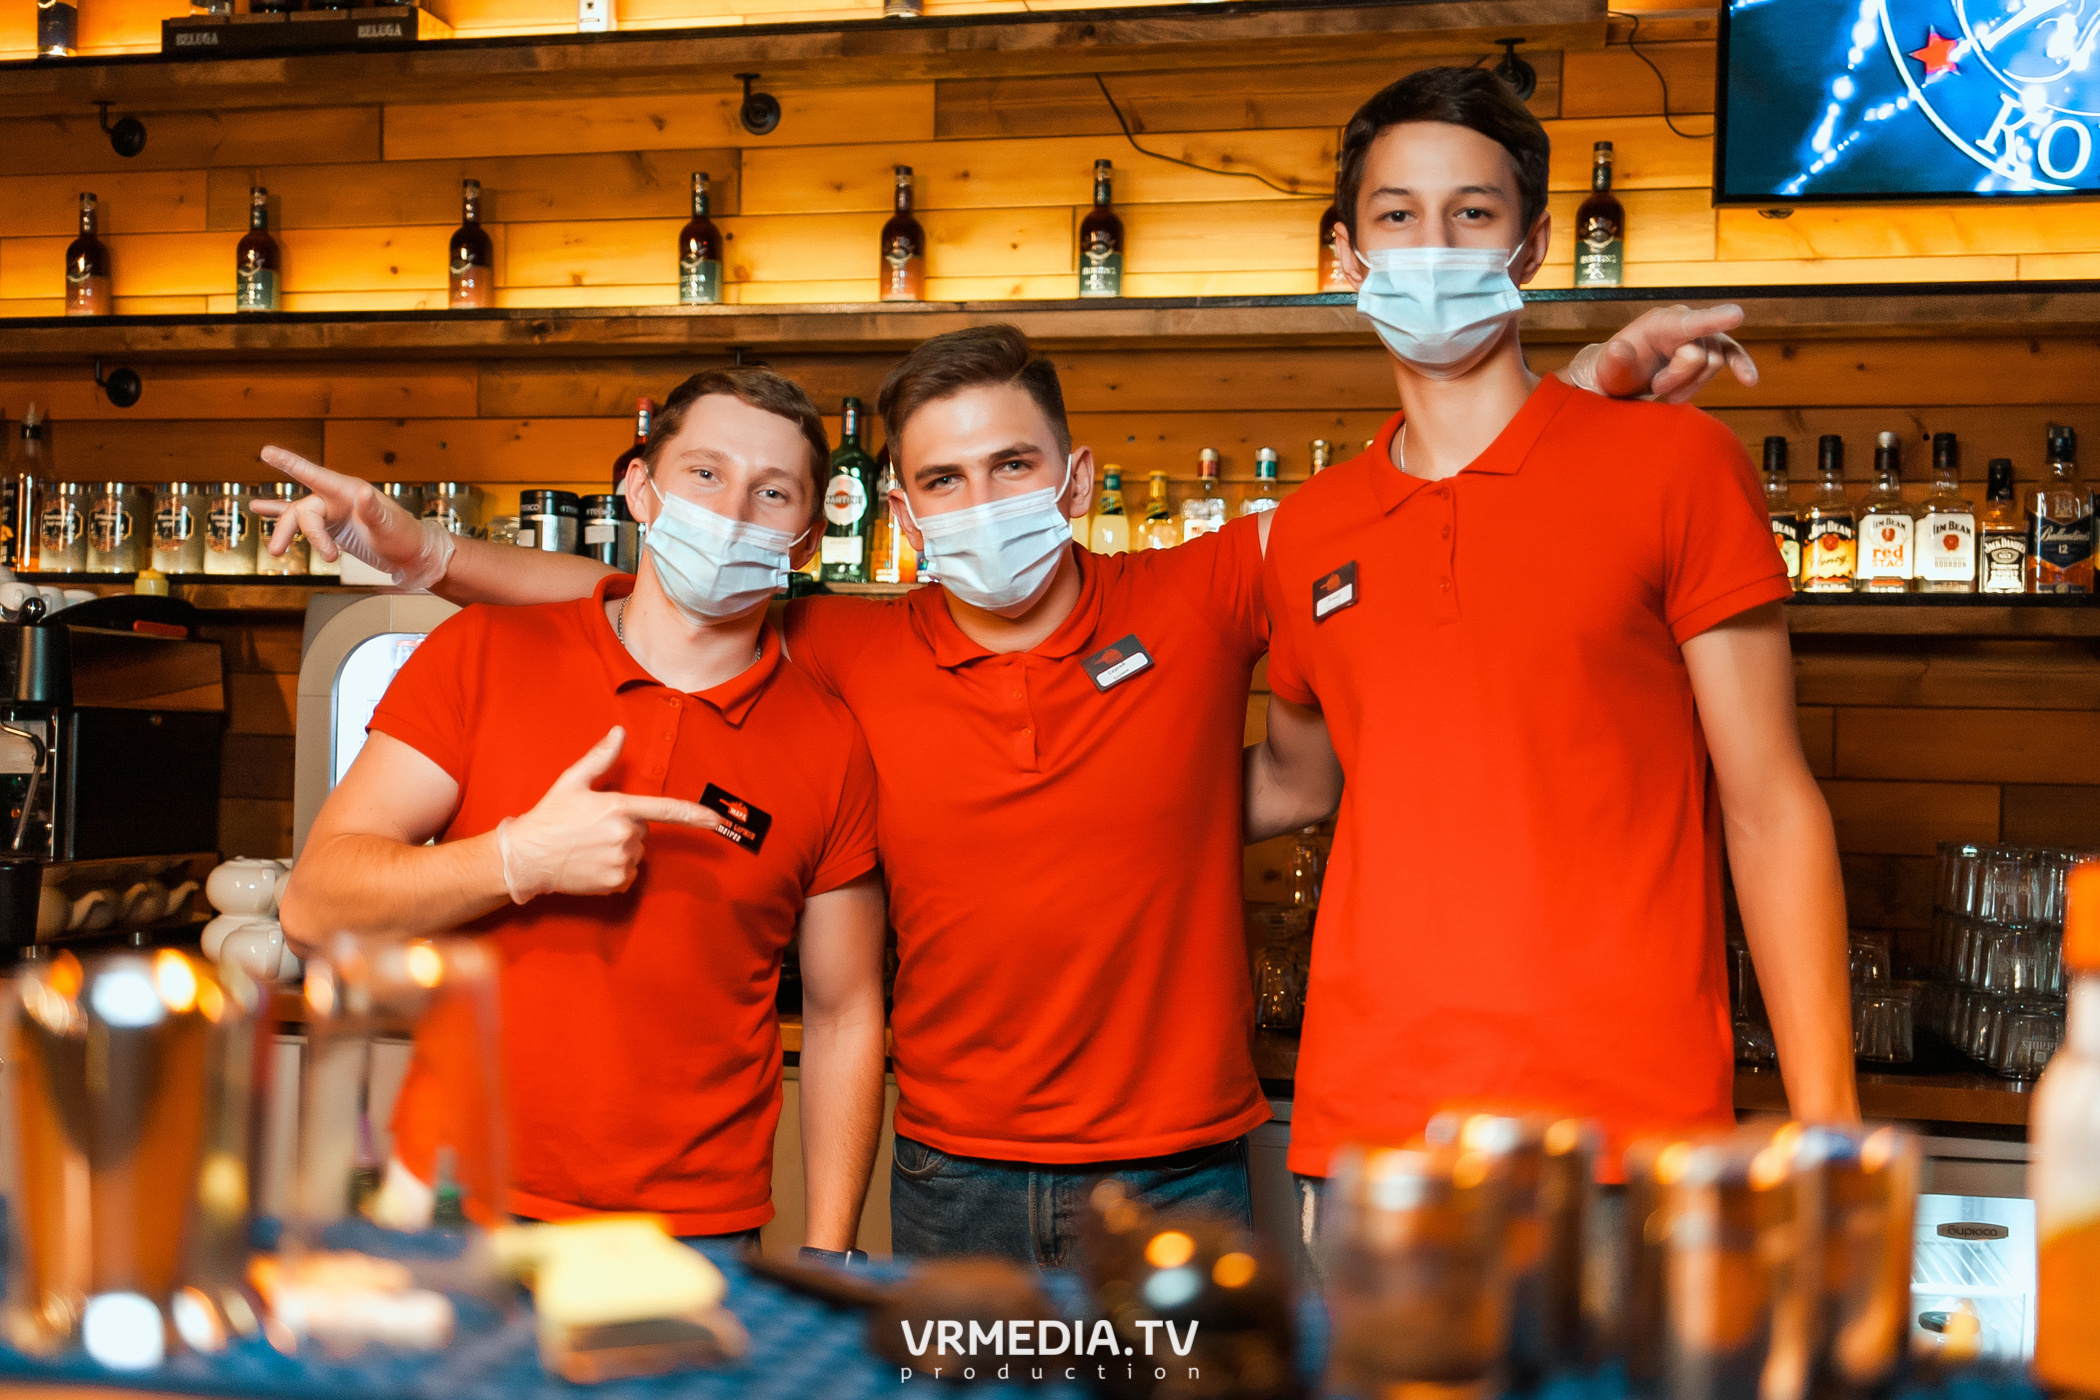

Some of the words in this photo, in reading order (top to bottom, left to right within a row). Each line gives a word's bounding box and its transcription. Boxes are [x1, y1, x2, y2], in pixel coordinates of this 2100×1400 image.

[358, 23, 402, 38] BELUGA
[176, 32, 218, 46] BELUGA
[1827, 520, 1852, 540] BEAM
[1886, 517, 1906, 531] BEAM
[1948, 520, 1971, 537] BEAM
[1872, 545, 1904, 558] red
[2058, 544, 2069, 554] 12
[1934, 560, 1967, 568] BOURBON
[730, 807, 747, 822] ЖАРА
